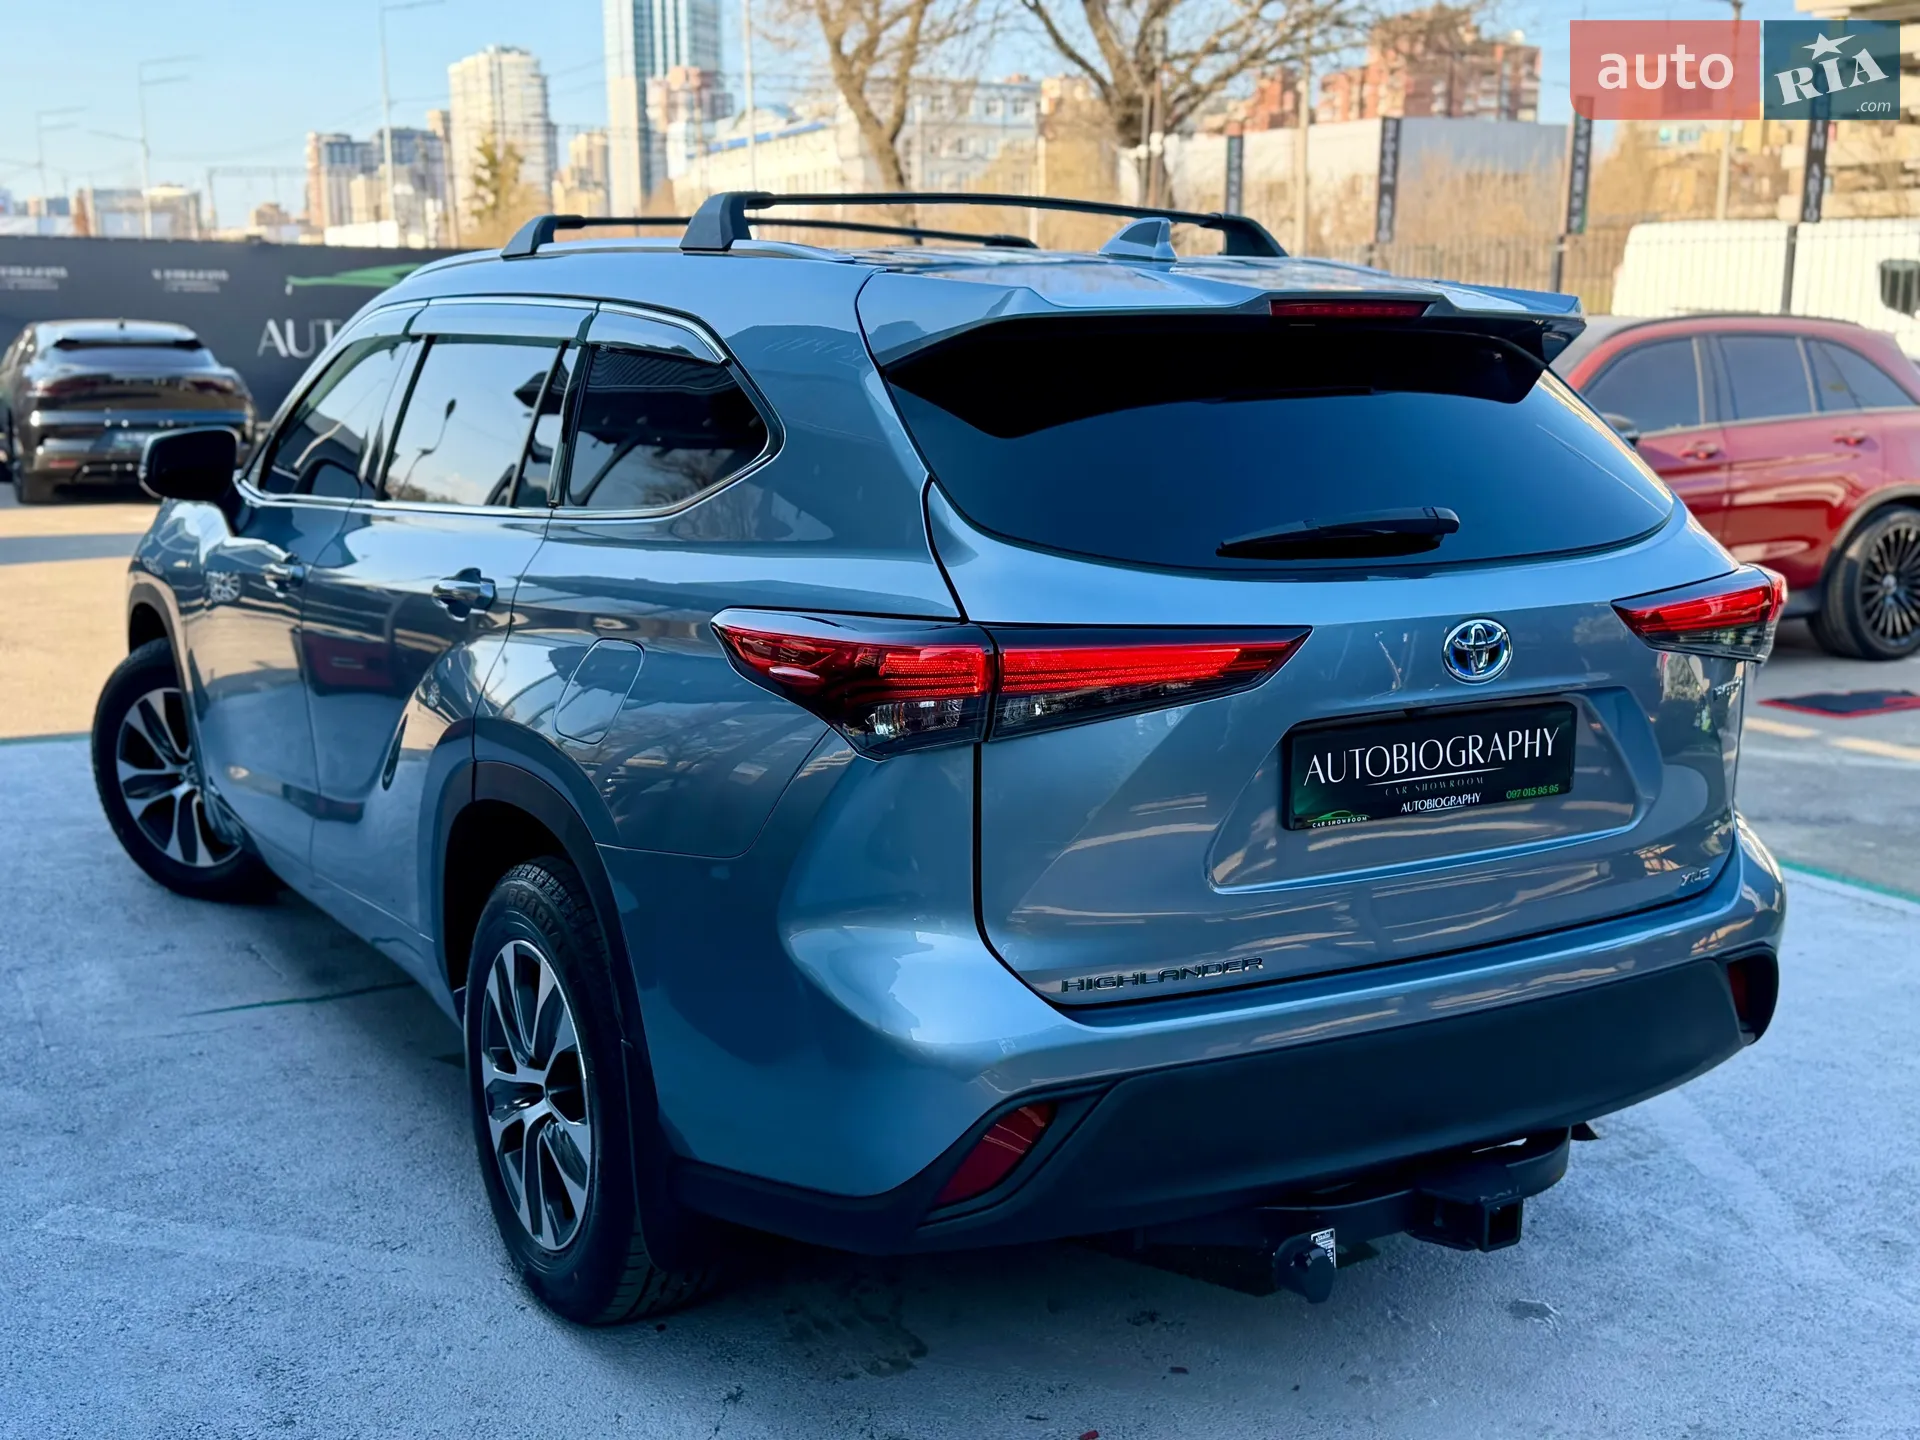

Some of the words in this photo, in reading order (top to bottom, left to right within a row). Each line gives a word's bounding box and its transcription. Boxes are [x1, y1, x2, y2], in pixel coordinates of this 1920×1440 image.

[1304, 727, 1559, 786] AUTOBIOGRAPHY
[1415, 777, 1484, 792] SHOWROOM
[1506, 788, 1521, 799] 097
[1522, 786, 1537, 797] 015
[1400, 792, 1482, 813] AUTOBIOGRAPHY
[1312, 821, 1326, 829] CAR
[1327, 816, 1368, 826] SHOWROOM
[1060, 956, 1264, 993] HIGHLANDER
